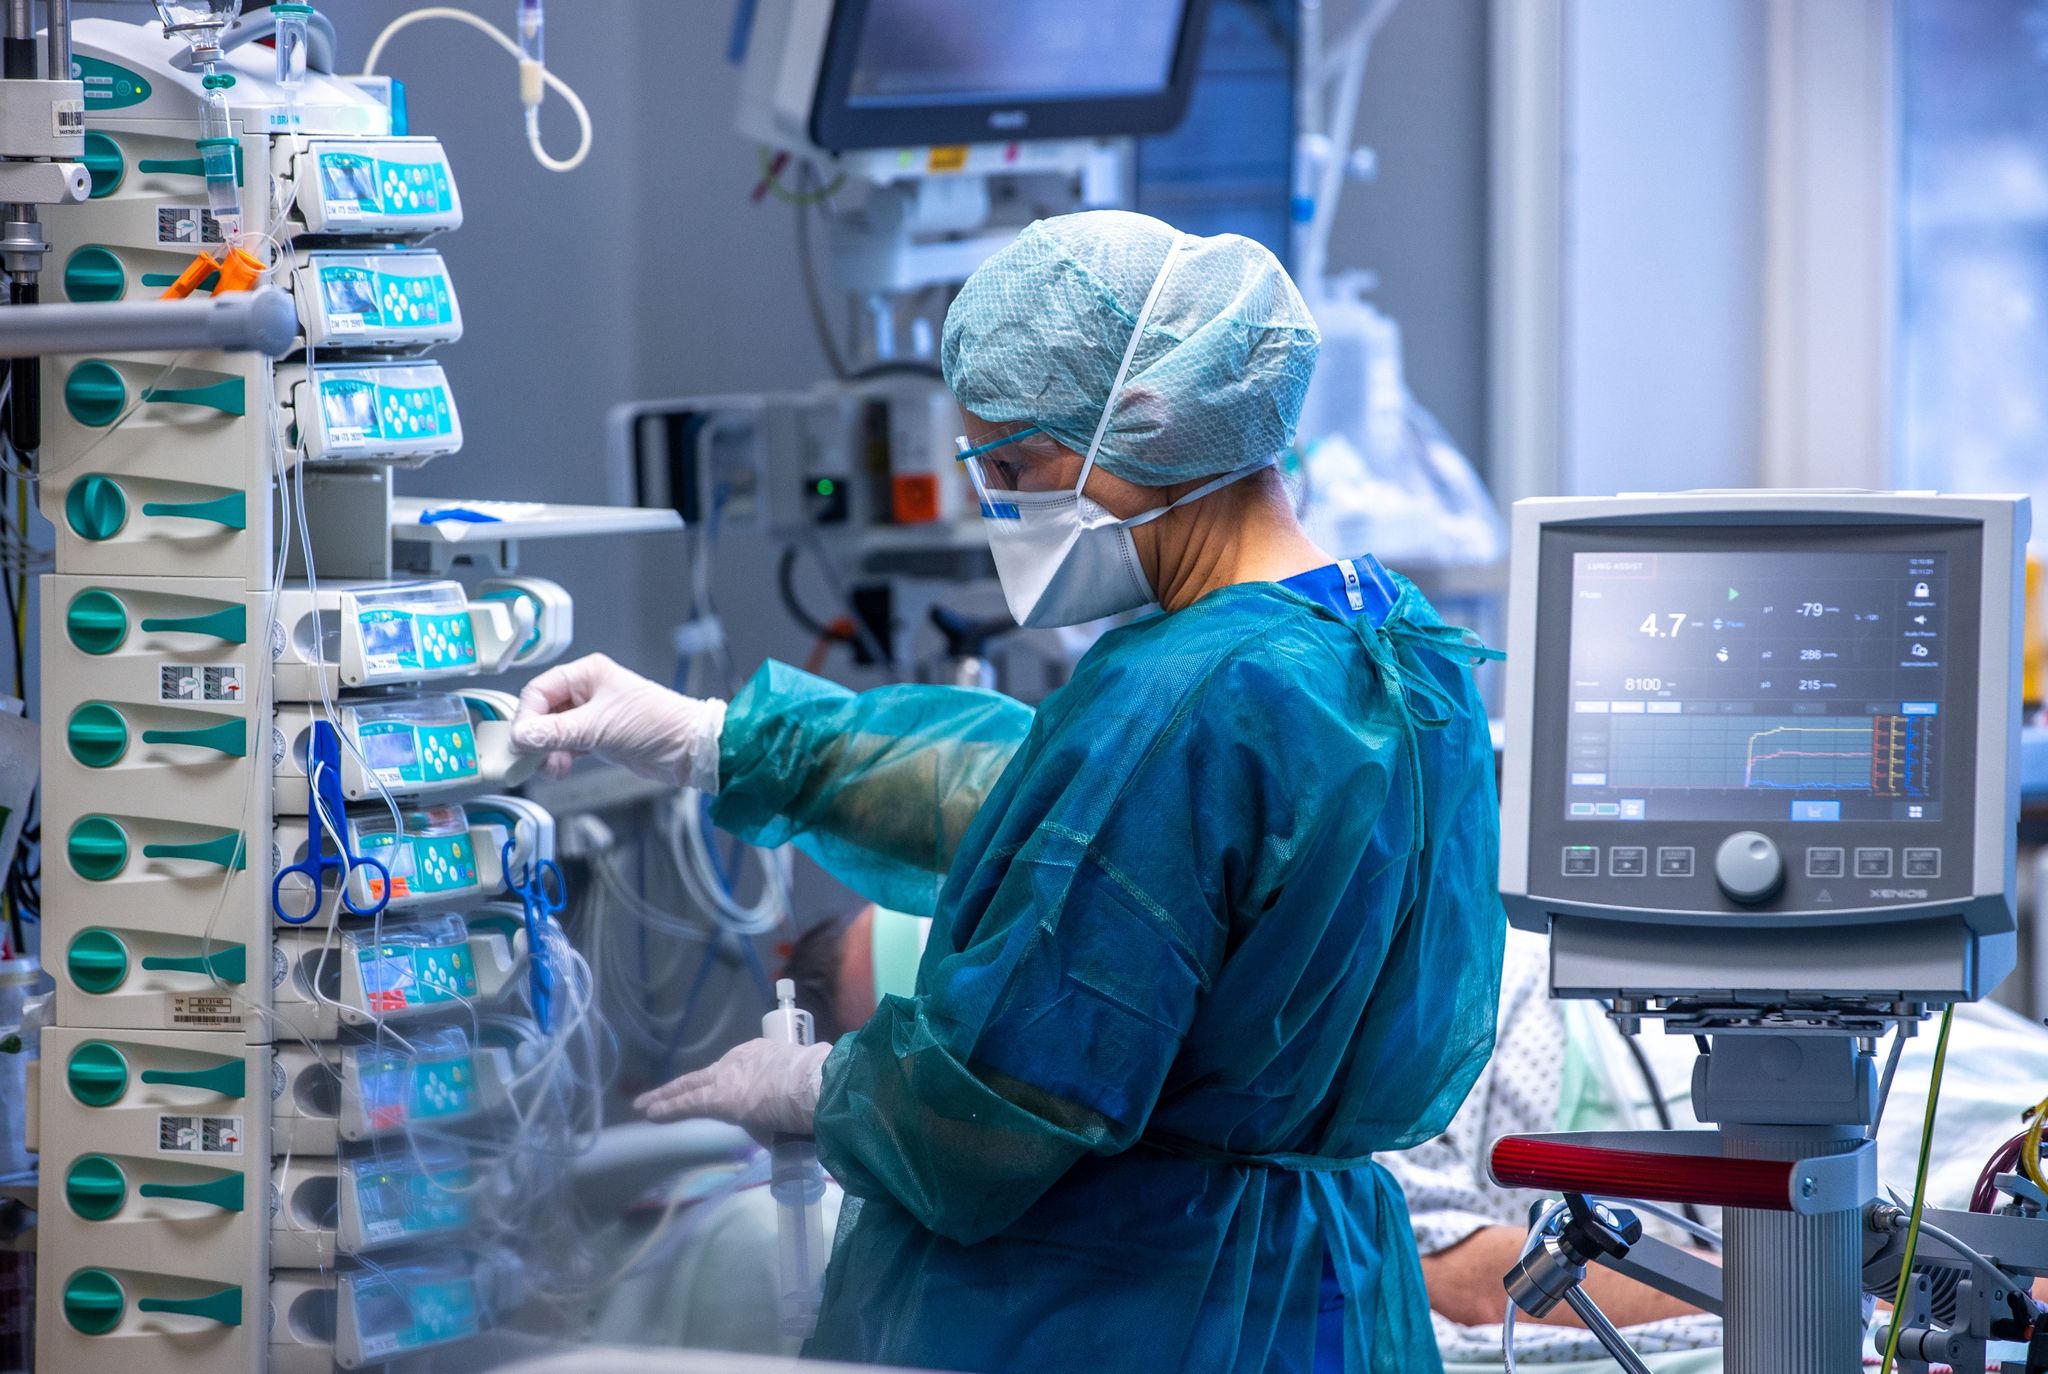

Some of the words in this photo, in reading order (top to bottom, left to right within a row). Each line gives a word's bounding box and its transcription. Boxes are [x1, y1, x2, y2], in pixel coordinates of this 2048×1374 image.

[277, 115, 300, 124] BRAN
[1587, 562, 1612, 570] LUNG
[1613, 562, 1644, 570] ASSIST
[1796, 602, 1823, 617] -79
[1639, 613, 1688, 638] 4.7
[1800, 649, 1822, 660] 286
[1624, 678, 1662, 691] 8100
[1798, 680, 1821, 691] 215
[1869, 889, 1929, 899] XENIOS
